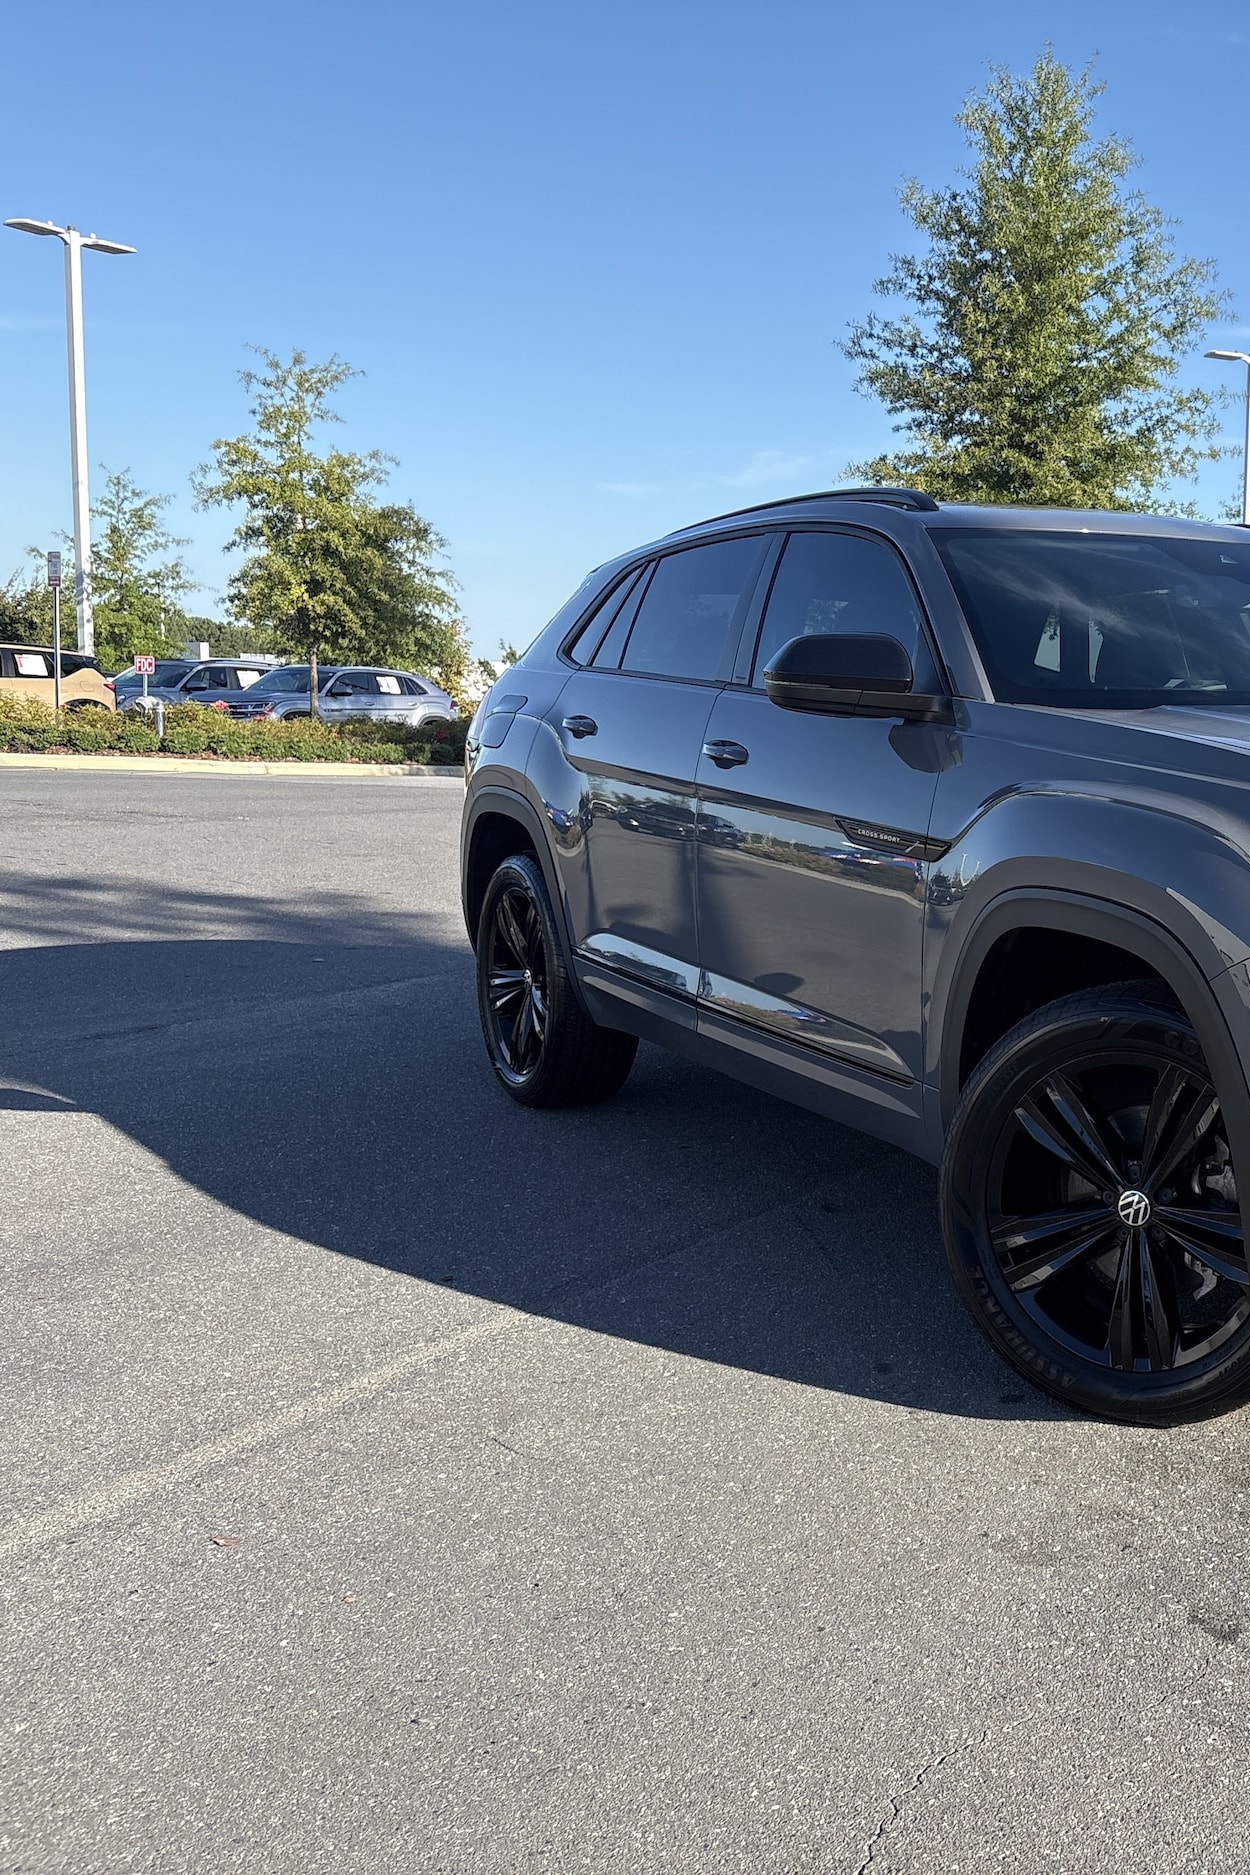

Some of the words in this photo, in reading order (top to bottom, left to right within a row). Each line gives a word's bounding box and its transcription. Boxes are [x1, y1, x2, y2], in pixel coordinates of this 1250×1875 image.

[136, 658, 152, 671] FDC
[857, 828, 878, 838] CROSS
[879, 834, 901, 843] SPORT
